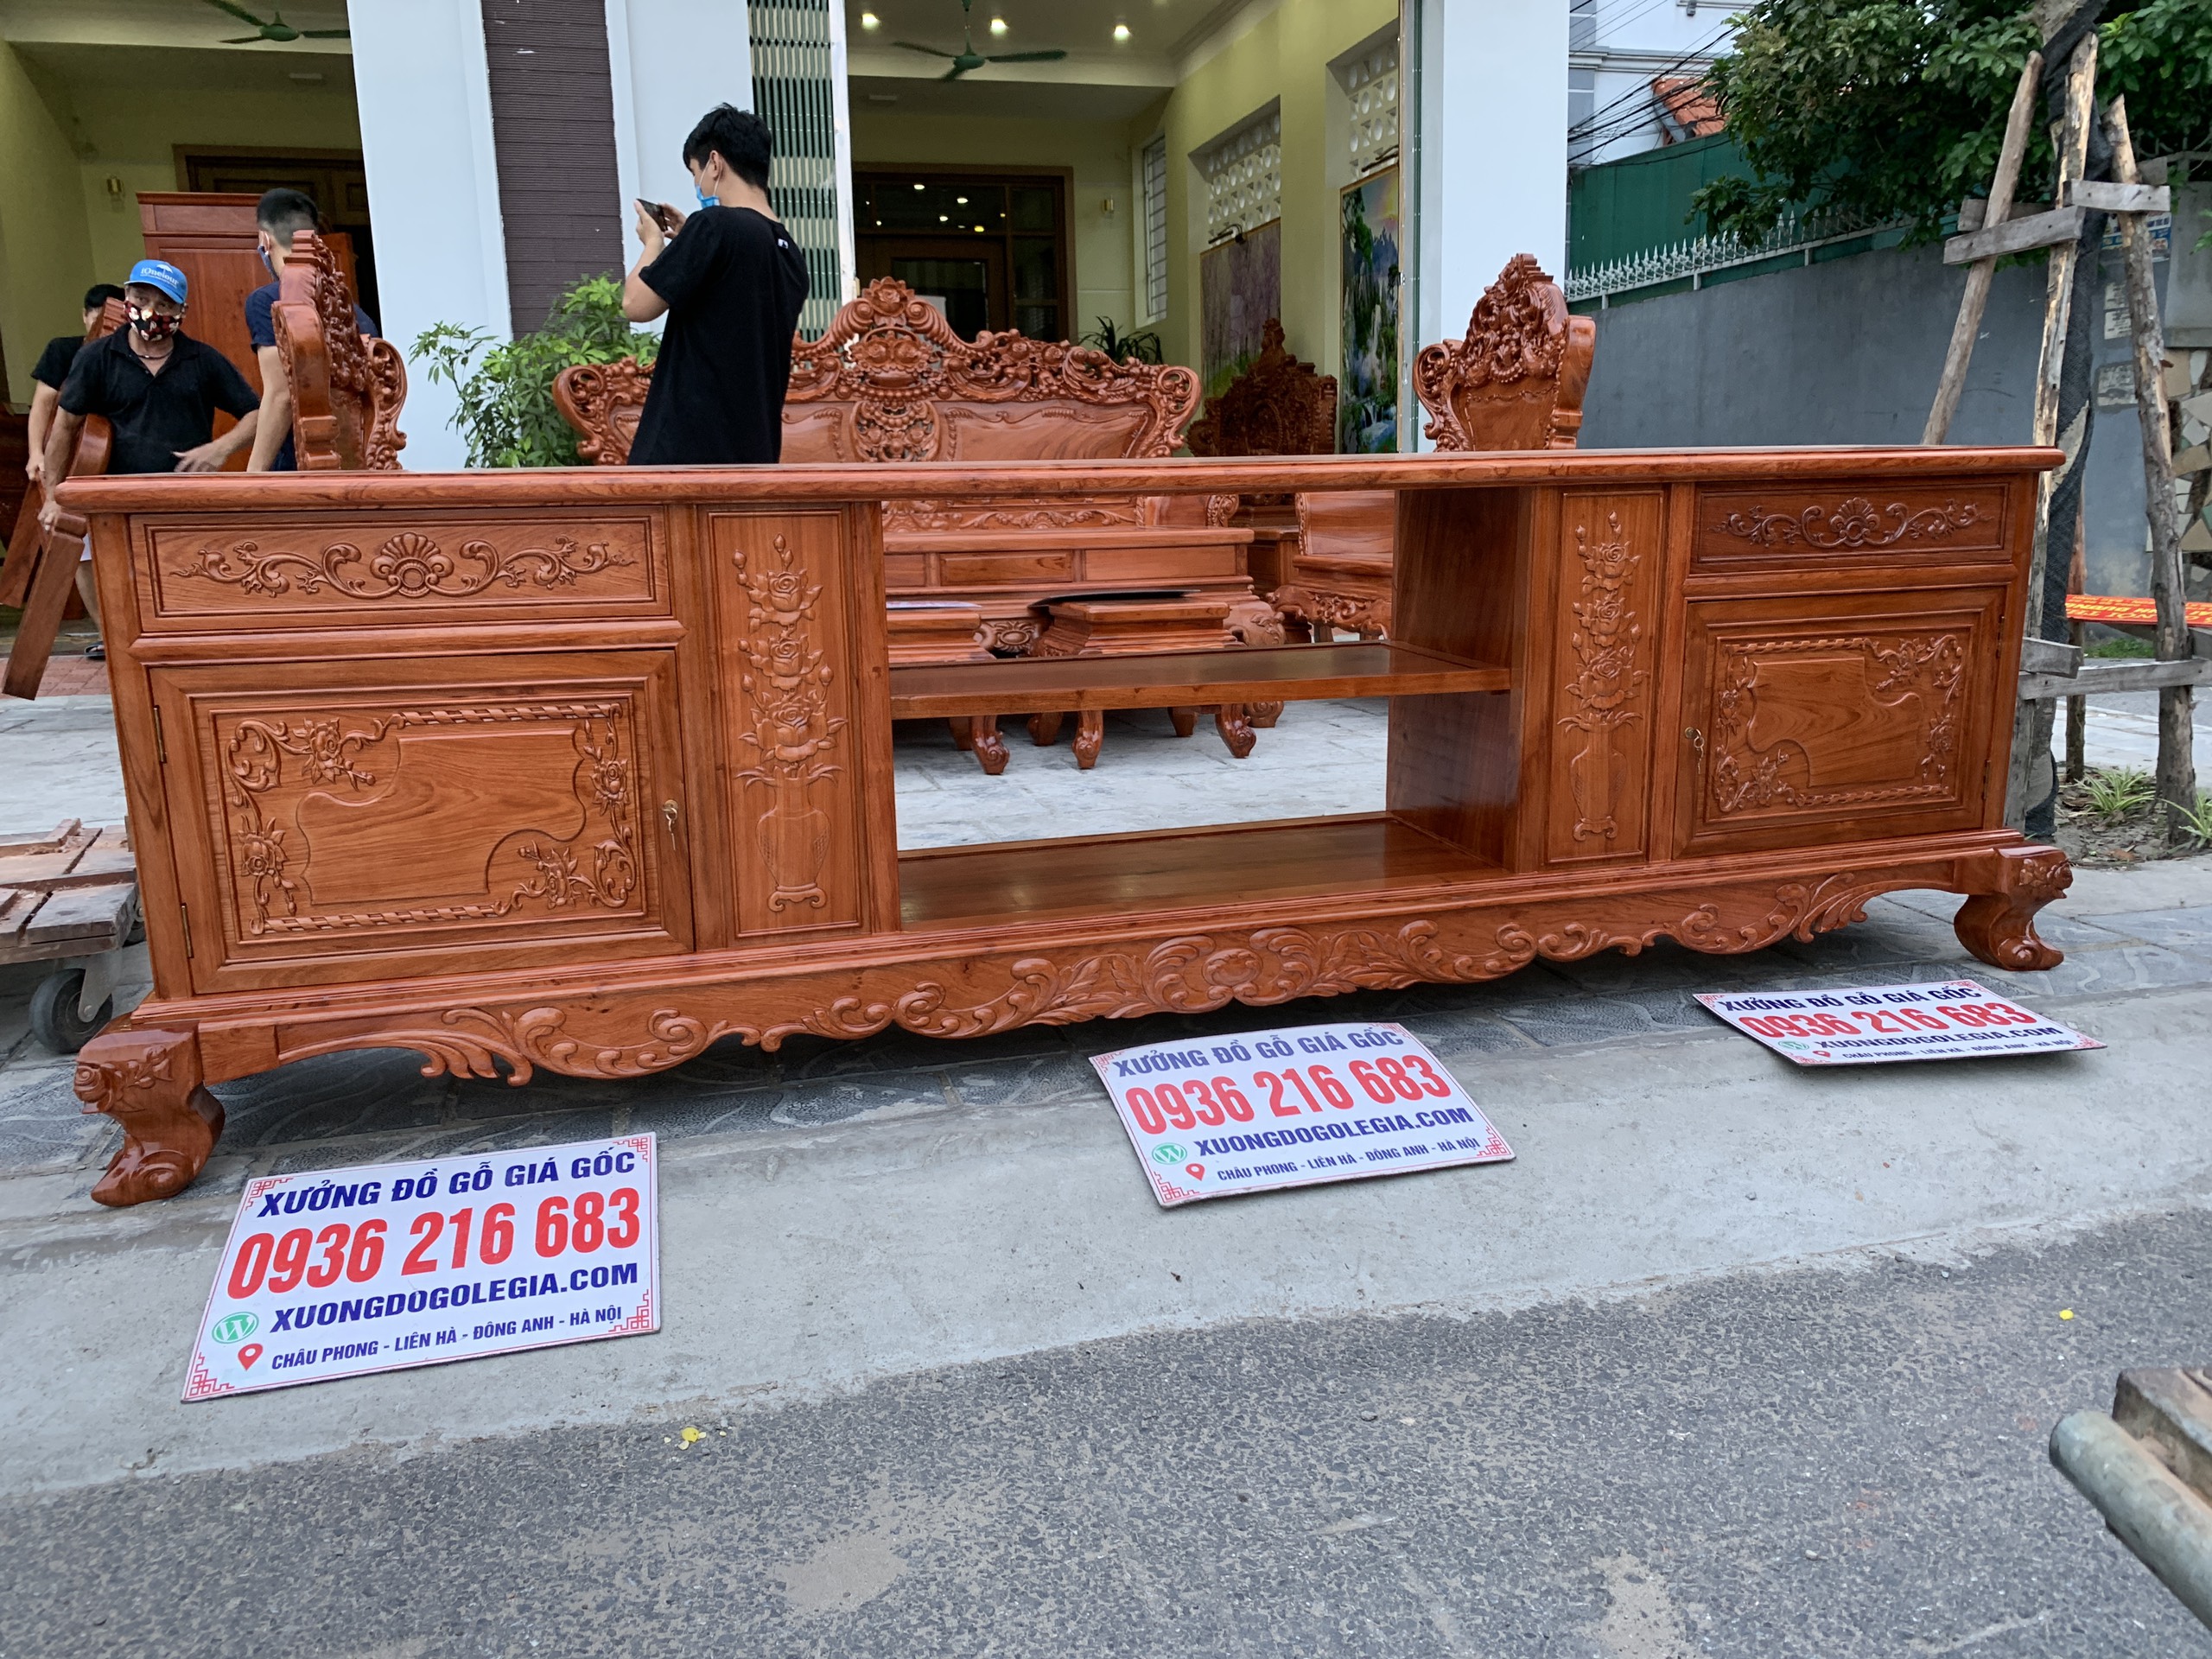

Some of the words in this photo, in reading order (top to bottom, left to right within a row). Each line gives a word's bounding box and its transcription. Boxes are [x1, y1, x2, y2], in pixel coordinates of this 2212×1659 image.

[1718, 997, 1808, 1011] XƯỞNG
[1804, 994, 1845, 1007] ĐỒ
[1844, 991, 1883, 1005] GỖ
[1882, 989, 1931, 1003] GIÁ
[1927, 985, 1982, 1000] GỐC
[1738, 1013, 1861, 1038] 0936
[1851, 1008, 1949, 1033] 216
[1936, 1002, 2037, 1027] 683
[1113, 1049, 1211, 1077] XƯỞNG
[1211, 1039, 1252, 1064] ĐỒ
[1255, 1034, 1294, 1058] GỖ
[1297, 1032, 1349, 1053] GIÁ
[1347, 1027, 1404, 1048] GỐC
[1815, 1027, 2064, 1048] XUONGDOGOLEGIA.COM
[1125, 1076, 1255, 1135] 0936
[1253, 1065, 1355, 1116] 216
[1349, 1054, 1452, 1104] 683
[1193, 1107, 1475, 1157] XUONGDOGOLEGIA.COM
[256, 1179, 381, 1218] XƯỞNG
[391, 1167, 438, 1202] ĐỒ
[449, 1160, 493, 1195] GỖ
[505, 1156, 559, 1187] GIÁ
[571, 1146, 635, 1179] GỐC
[1217, 1167, 1253, 1181] CHÂU
[1253, 1161, 1299, 1177] PHONG
[1306, 1156, 1338, 1170] LIÊN
[1338, 1151, 1357, 1165] HÀ
[1364, 1147, 1402, 1161] ĐÔNG
[1402, 1144, 1430, 1156] ANH
[1437, 1137, 1458, 1152] HÀ
[1456, 1135, 1481, 1151] NỘI
[227, 1218, 389, 1300] 0936
[402, 1202, 515, 1276] 216
[535, 1186, 641, 1259] 683
[269, 1262, 638, 1333] XUONGDOGOLEGIA.COM
[271, 1348, 317, 1370] CHÂU
[321, 1341, 379, 1363] PHONG
[394, 1332, 432, 1353] LIÊN
[435, 1326, 457, 1347] HÀ
[473, 1319, 517, 1340] ĐÔNG
[521, 1315, 555, 1334] ANH
[569, 1309, 591, 1326] HÀ
[594, 1305, 622, 1324] NỘI
